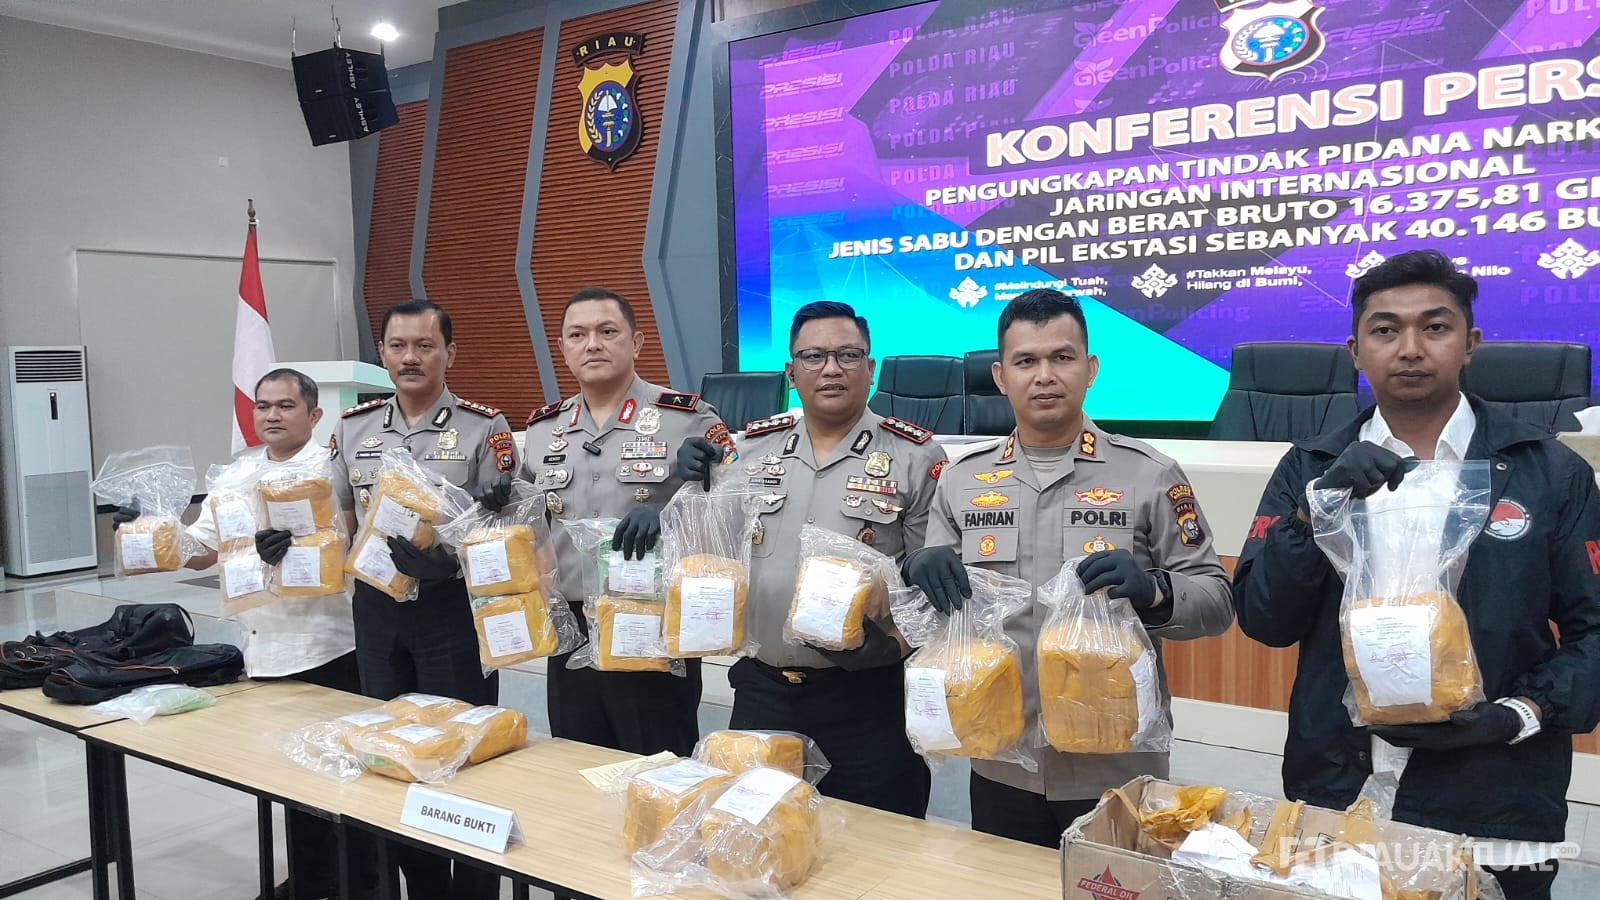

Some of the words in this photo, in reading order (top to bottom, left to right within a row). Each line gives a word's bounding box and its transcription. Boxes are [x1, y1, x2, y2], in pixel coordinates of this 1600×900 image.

[578, 36, 634, 57] RIAU
[890, 54, 954, 78] POLDA
[965, 41, 1015, 65] RIAU
[760, 72, 843, 97] PRESISI
[965, 80, 1016, 102] RIAU
[761, 107, 844, 131] PRESISI
[986, 79, 1404, 168] KONFERENSI
[890, 127, 955, 150] POLDA
[762, 142, 845, 164] PRESISI
[890, 164, 955, 186] POLDA
[925, 162, 1170, 207] PENGUNGKAPAN
[1174, 148, 1310, 180] TINDAK
[1318, 131, 1473, 167] PIDANA
[1049, 183, 1211, 218] JARINGAN
[1220, 154, 1537, 202] INTERNASIONAL
[829, 237, 894, 259] JENIS
[899, 231, 968, 253] SABU
[975, 219, 1100, 247] DENGAN
[1108, 208, 1209, 236] BERAT
[1216, 199, 1337, 228] BRUTO
[1348, 182, 1540, 217] 16.375,81
[955, 249, 1014, 271] DAN
[1022, 246, 1065, 266] PIL
[1072, 235, 1197, 262] EKSTASI
[1206, 220, 1397, 253] SEBANYAK
[1405, 210, 1547, 240] 40.146
[1071, 276, 1108, 287] Tuah,
[1186, 268, 1247, 279] #Takkan
[1250, 265, 1312, 276] Melayu,
[1186, 280, 1232, 290] Hilang
[1235, 278, 1251, 288] di
[1255, 276, 1303, 287] Bumi,
[490, 432, 512, 444] POLDA
[965, 512, 1014, 527] FAHRIAN
[1071, 511, 1127, 526] POLRI
[420, 805, 462, 825] BARANG
[464, 817, 496, 835] BUKTI
[1081, 880, 1118, 896] FEDERAL
